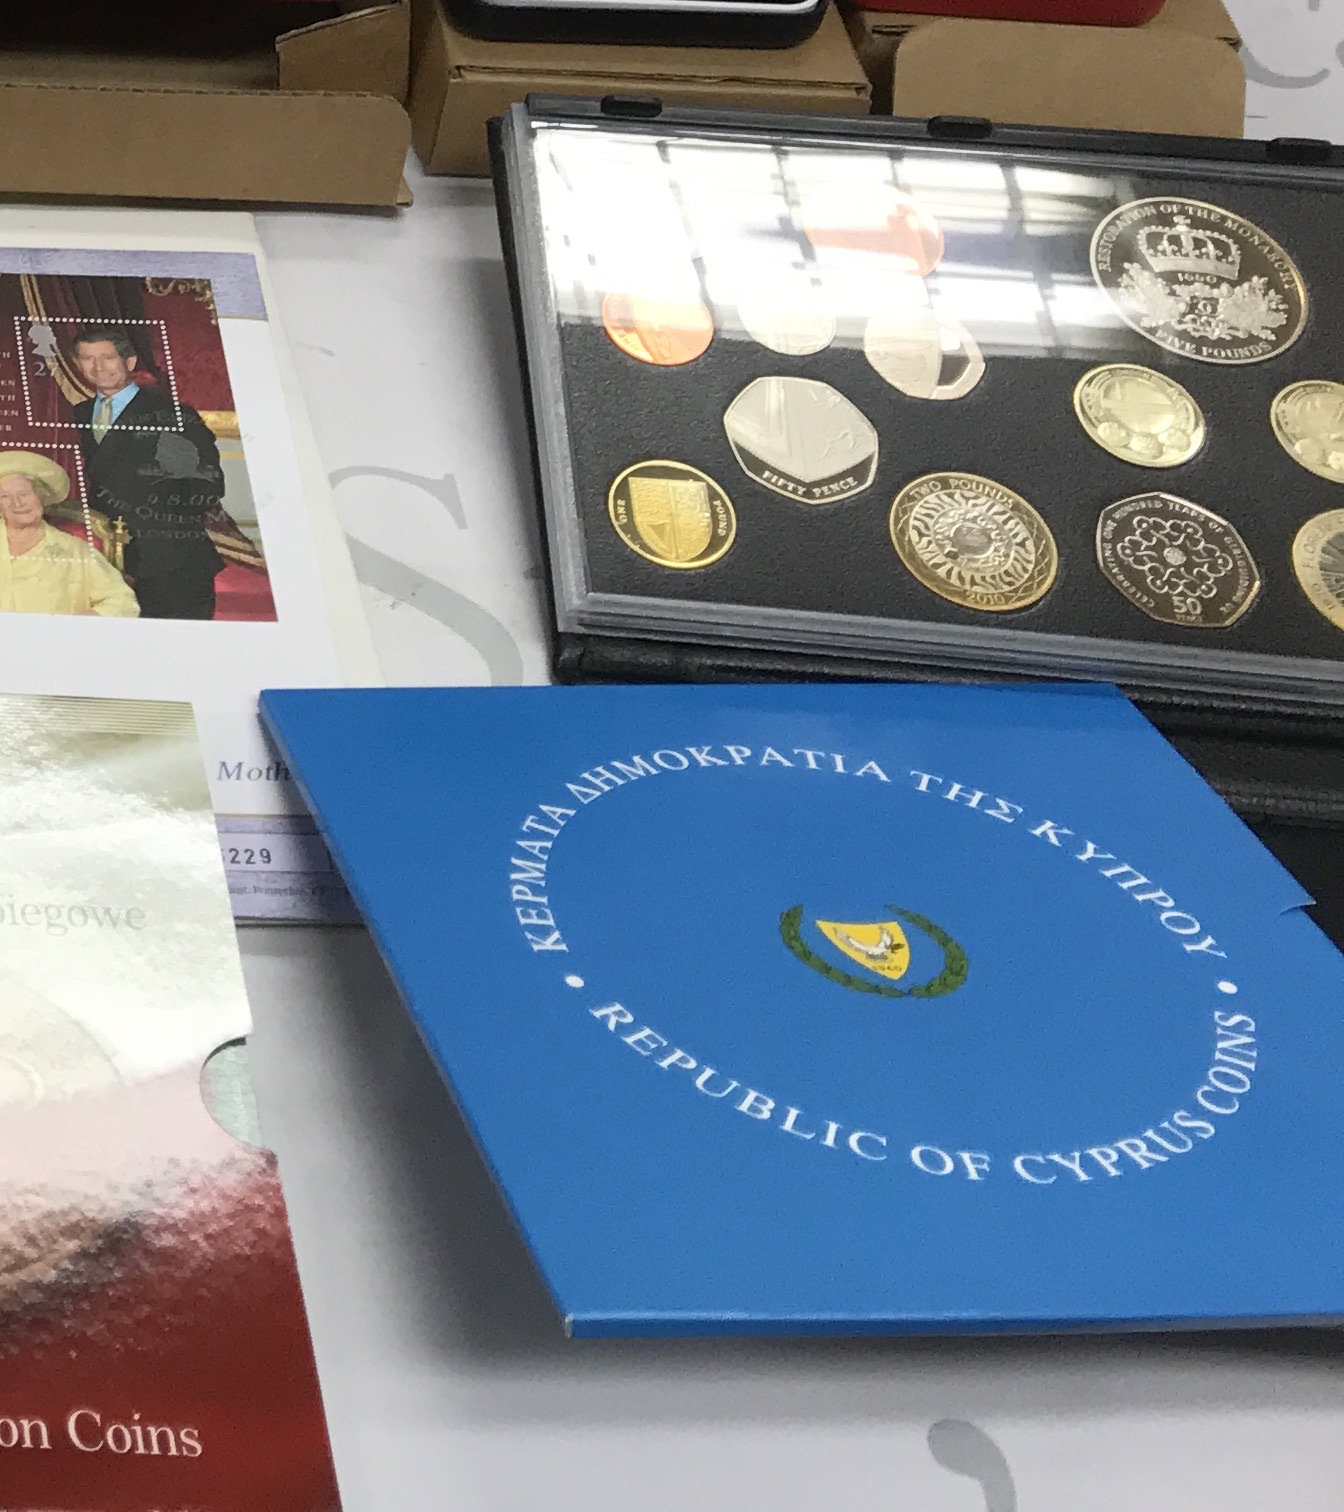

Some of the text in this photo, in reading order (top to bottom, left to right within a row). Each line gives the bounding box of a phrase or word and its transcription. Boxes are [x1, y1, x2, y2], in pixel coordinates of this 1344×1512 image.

[1160, 204, 1182, 214] OF
[1185, 205, 1221, 223] THE
[1176, 272, 1218, 284] 1660
[1154, 328, 1273, 359] FIVE POUNDS
[761, 469, 859, 499] FIFTY PENCE
[909, 478, 1014, 506] TWO POUNDS
[965, 589, 1006, 605] 2010
[1172, 595, 1203, 615] 50
[588, 1000, 1258, 1186] REPUBLIC OF CYPRUS COINS
[66, 1409, 205, 1460] Coins
